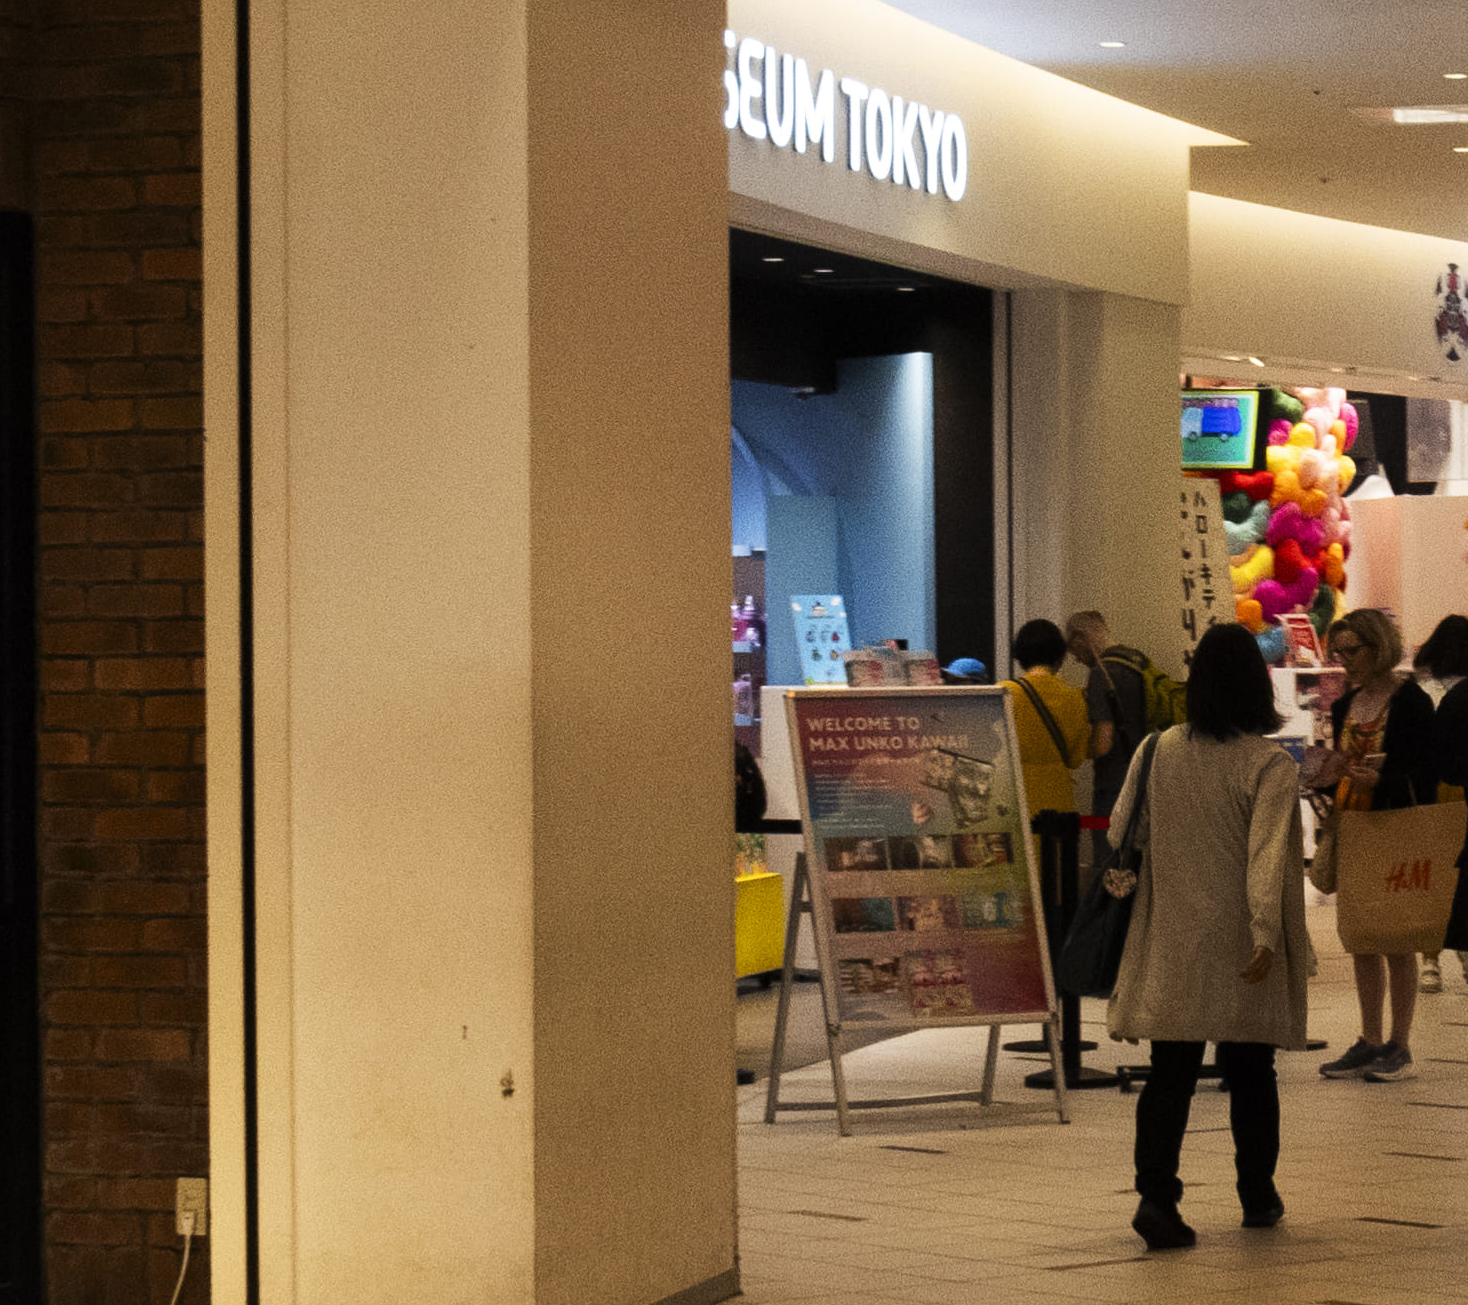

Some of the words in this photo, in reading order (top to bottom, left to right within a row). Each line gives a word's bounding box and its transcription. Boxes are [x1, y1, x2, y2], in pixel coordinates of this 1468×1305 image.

[840, 77, 968, 202] TOKYO
[808, 717, 892, 732] WELCOME
[896, 717, 920, 730] TO
[809, 736, 848, 751] MAX
[853, 735, 902, 750] UNKO
